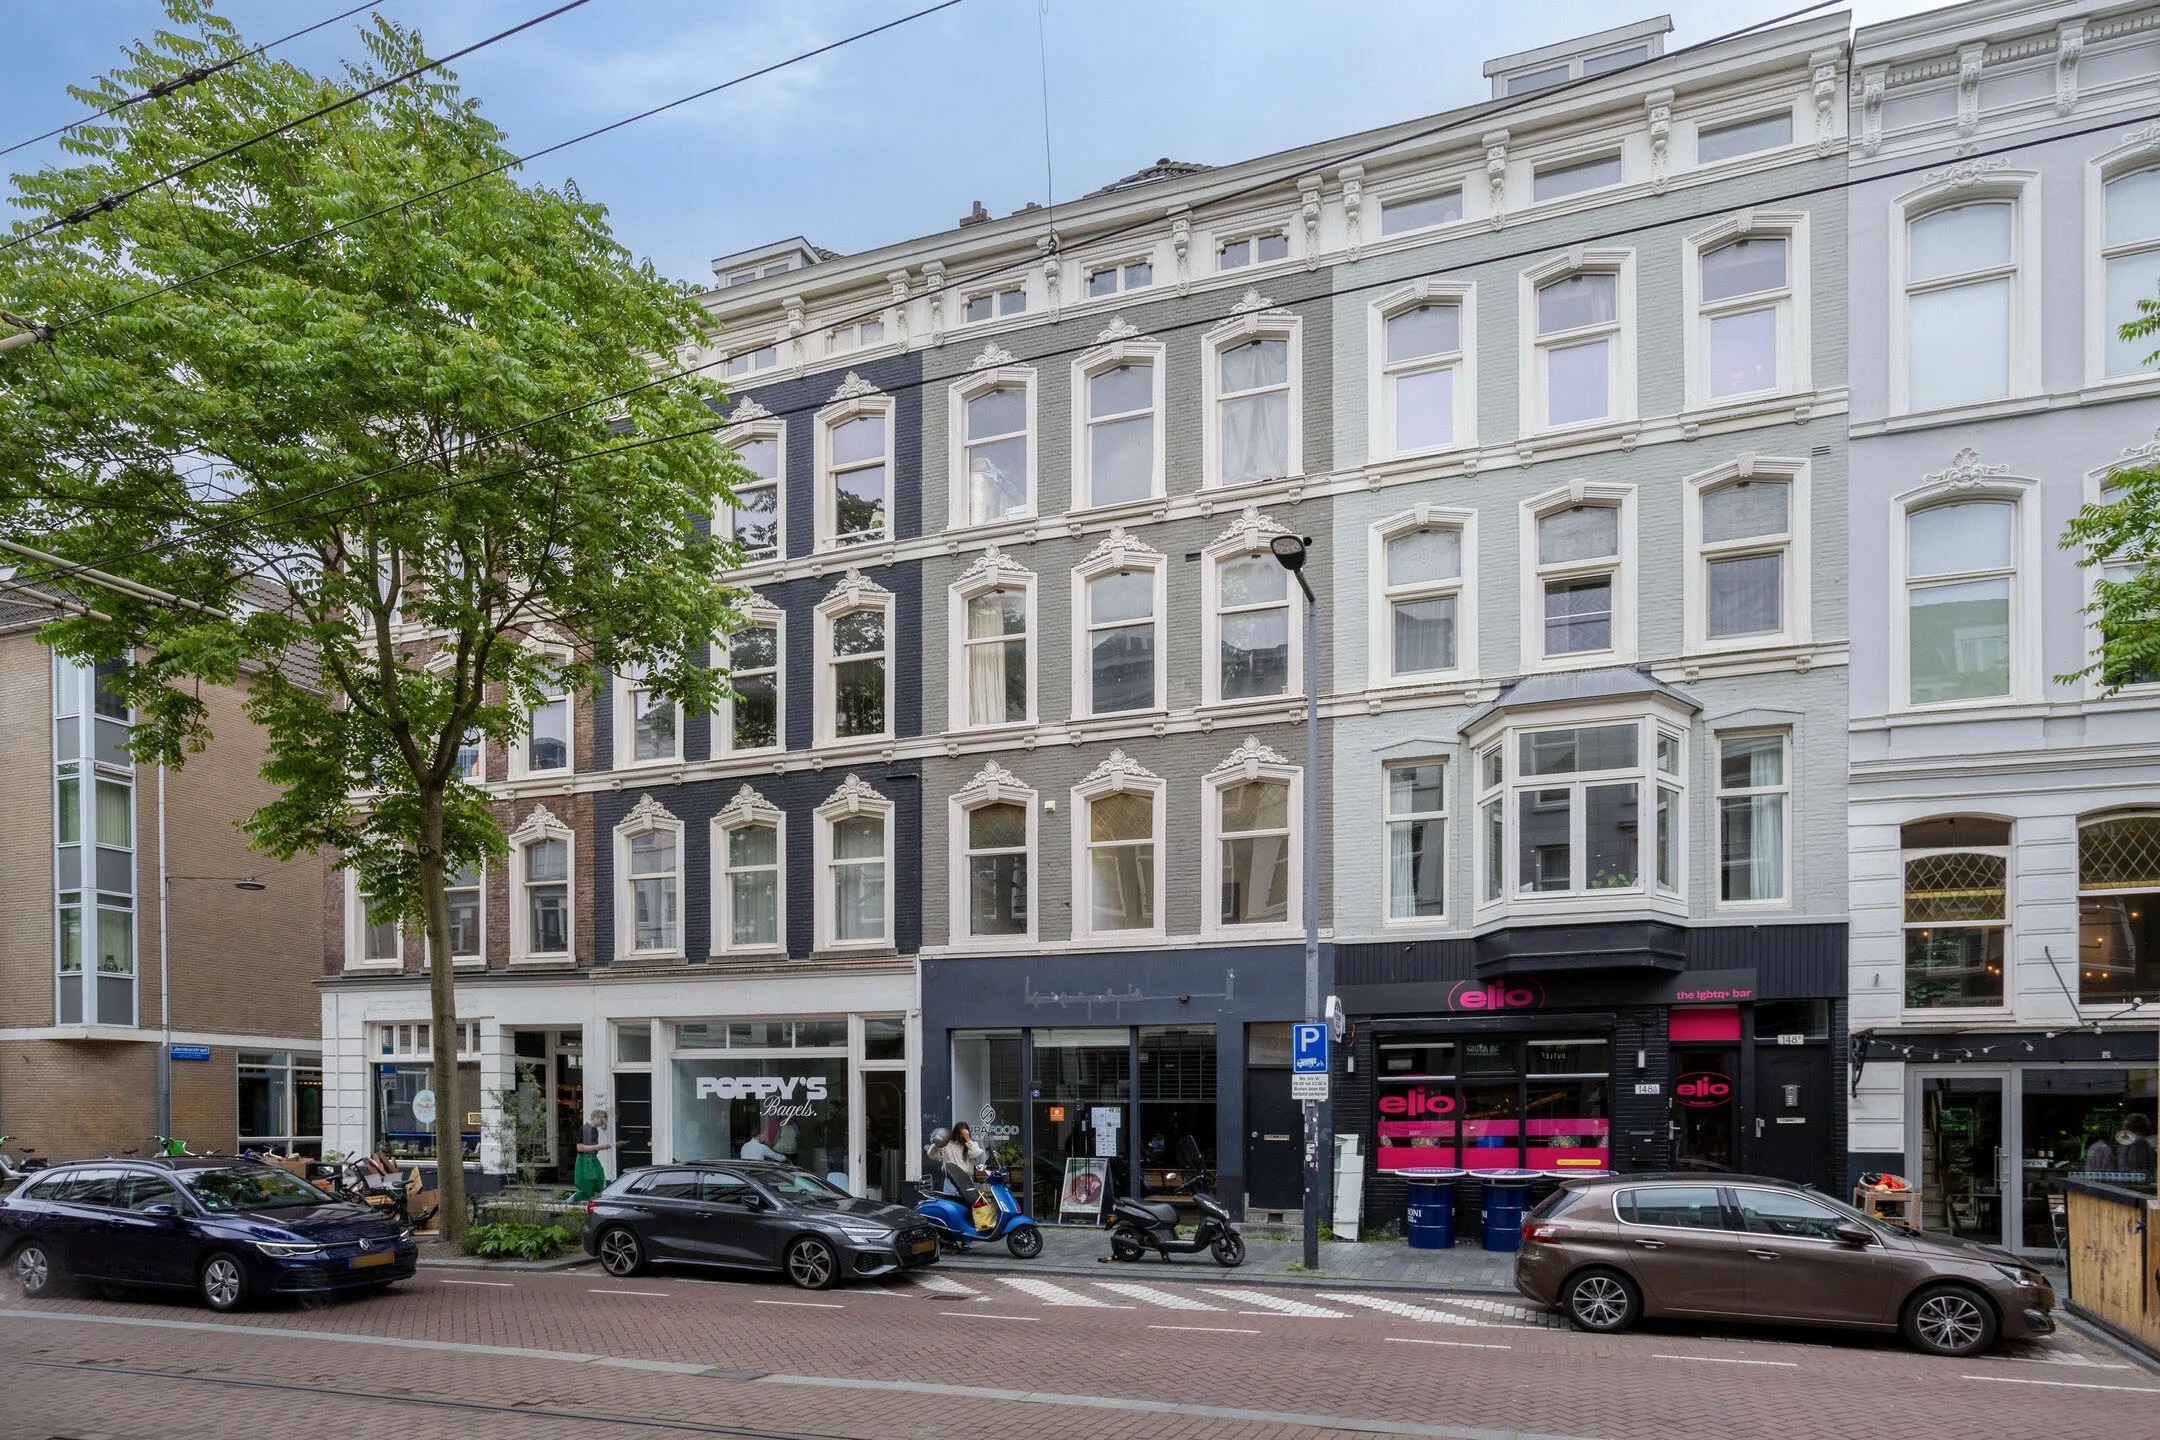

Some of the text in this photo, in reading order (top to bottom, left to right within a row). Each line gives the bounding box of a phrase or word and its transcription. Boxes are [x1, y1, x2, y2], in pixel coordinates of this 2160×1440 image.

[1460, 978, 1533, 1010] elio
[1676, 988, 1752, 1000] the lgbtq+ bar
[1301, 1028, 1320, 1052] P
[696, 1077, 828, 1100] POPPY'S
[1677, 1076, 1729, 1097] elio
[760, 1095, 818, 1126] Bagels.
[1378, 1085, 1456, 1116] elio
